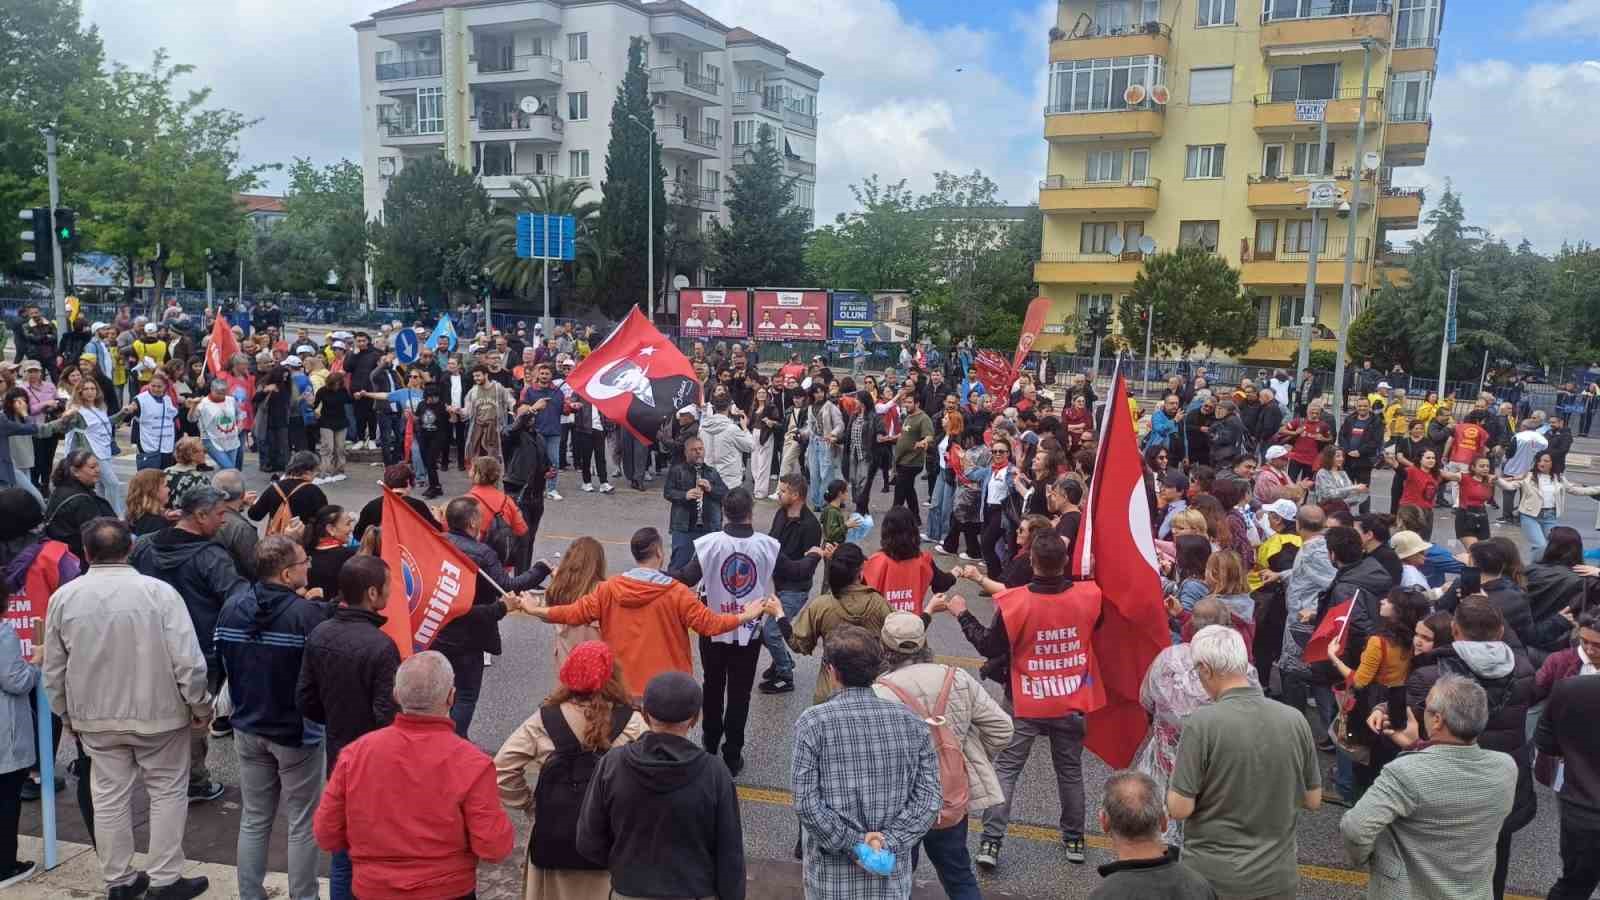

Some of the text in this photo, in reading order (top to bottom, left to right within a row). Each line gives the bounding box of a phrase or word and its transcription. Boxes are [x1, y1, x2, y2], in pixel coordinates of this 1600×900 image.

[415, 560, 461, 644] Eğitim
[1037, 627, 1077, 640] EMEK
[1035, 640, 1081, 655] EYLEM
[1020, 674, 1082, 700] Eğitim
